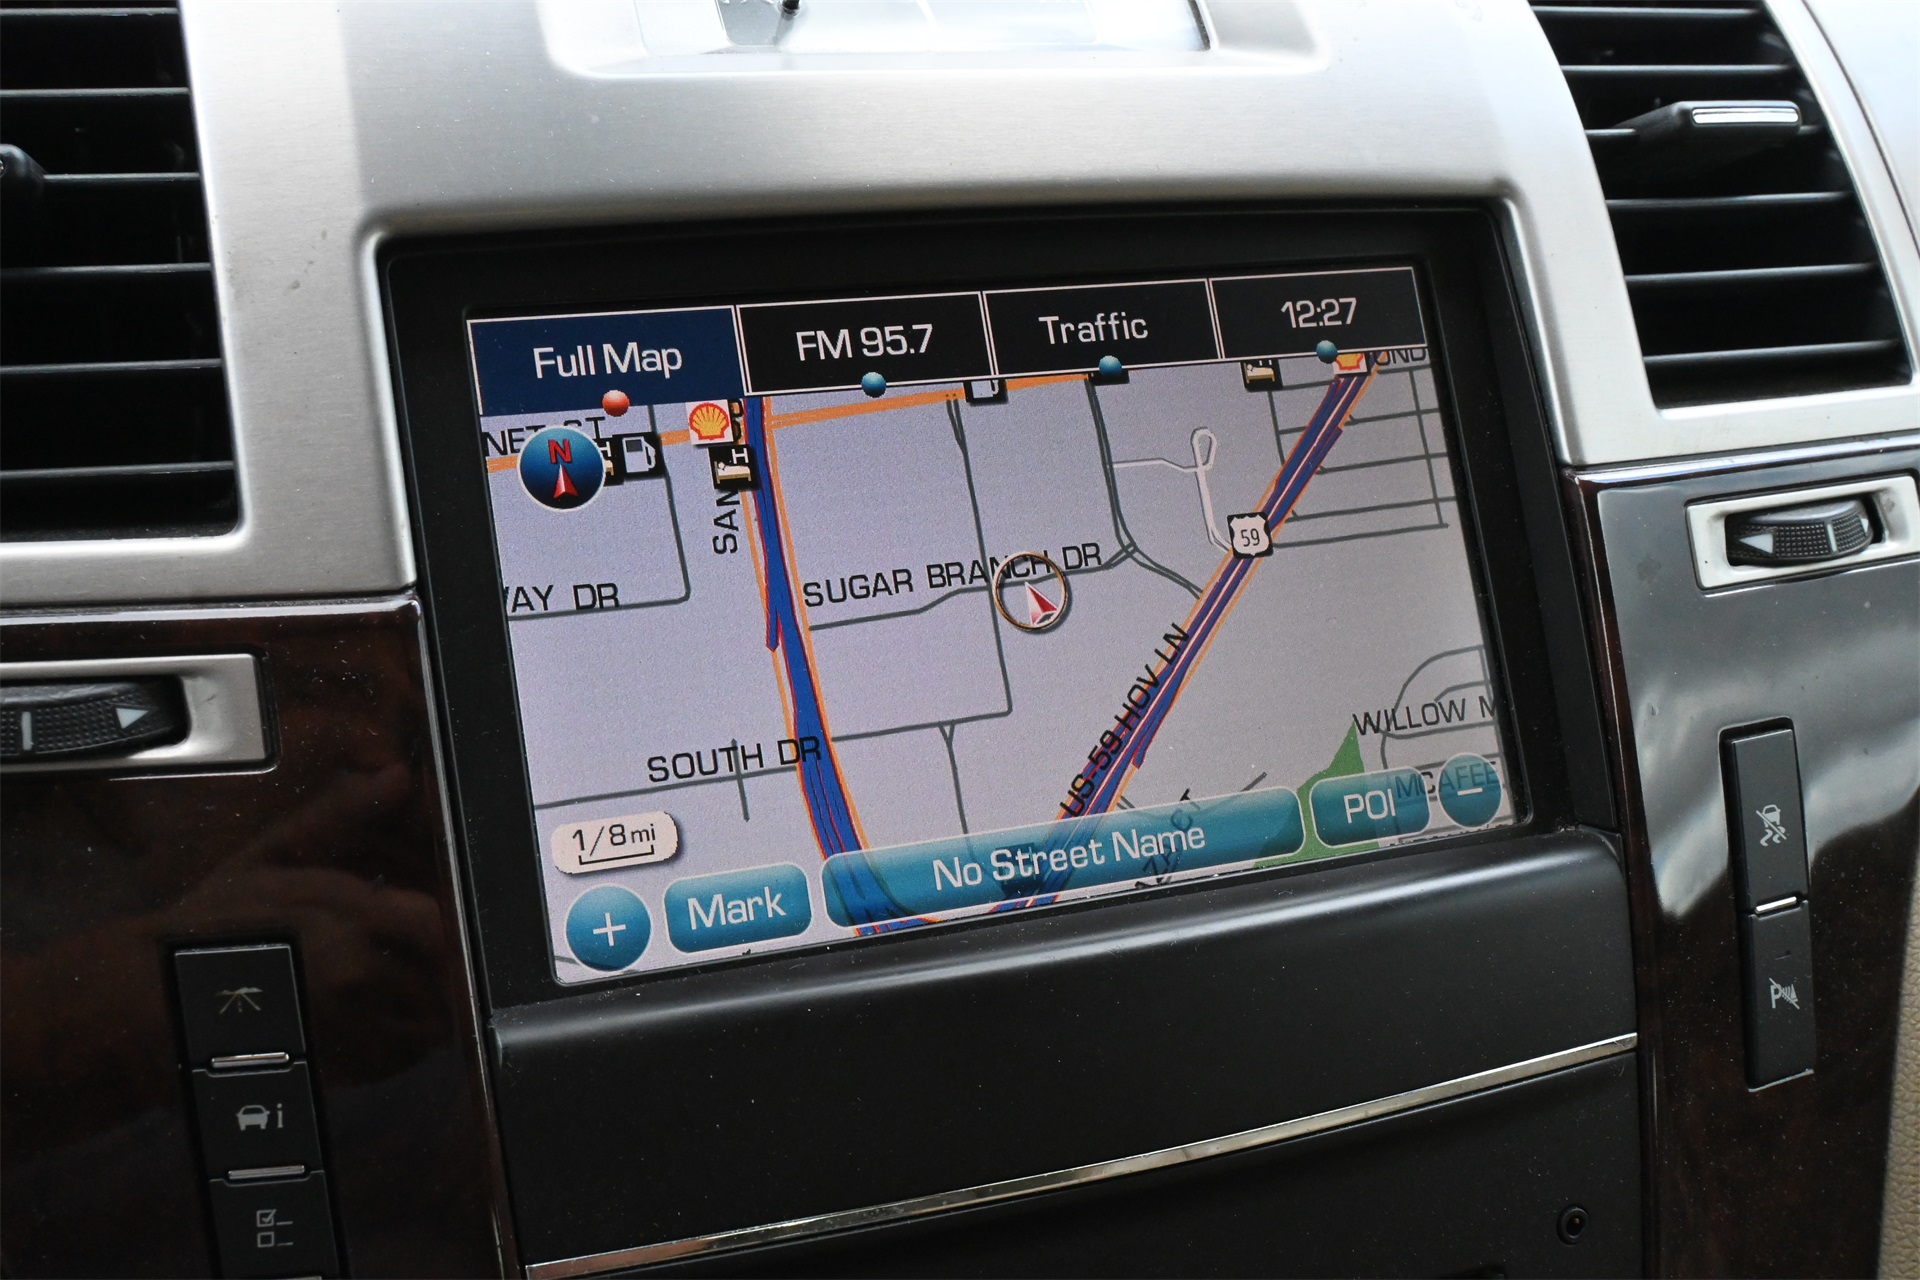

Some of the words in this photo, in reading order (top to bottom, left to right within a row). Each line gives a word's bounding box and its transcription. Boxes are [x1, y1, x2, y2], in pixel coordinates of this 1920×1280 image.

[1038, 311, 1149, 345] Traffic
[1281, 297, 1357, 328] 12:27
[533, 344, 596, 379] Full
[602, 341, 683, 379] Map
[796, 328, 853, 361] FM
[860, 323, 933, 357] 95.7
[1240, 528, 1260, 547] 59
[803, 568, 914, 607] SUGAR
[926, 549, 1051, 589] BRANCH
[1062, 542, 1101, 571] DR
[503, 584, 554, 613] AY
[573, 583, 620, 611] DR
[1060, 729, 1123, 817] US-59
[1114, 664, 1160, 731] HOV
[1154, 622, 1190, 664] LN
[1352, 698, 1466, 736] WILLOW
[647, 743, 764, 783] SOUTH
[777, 735, 822, 766] DR
[1343, 788, 1396, 824] POI
[572, 823, 627, 857] 1/8
[630, 823, 657, 844] mi
[933, 856, 983, 890] No
[990, 838, 1106, 881] Street
[1111, 826, 1206, 862] Name
[687, 886, 788, 931] Mark
